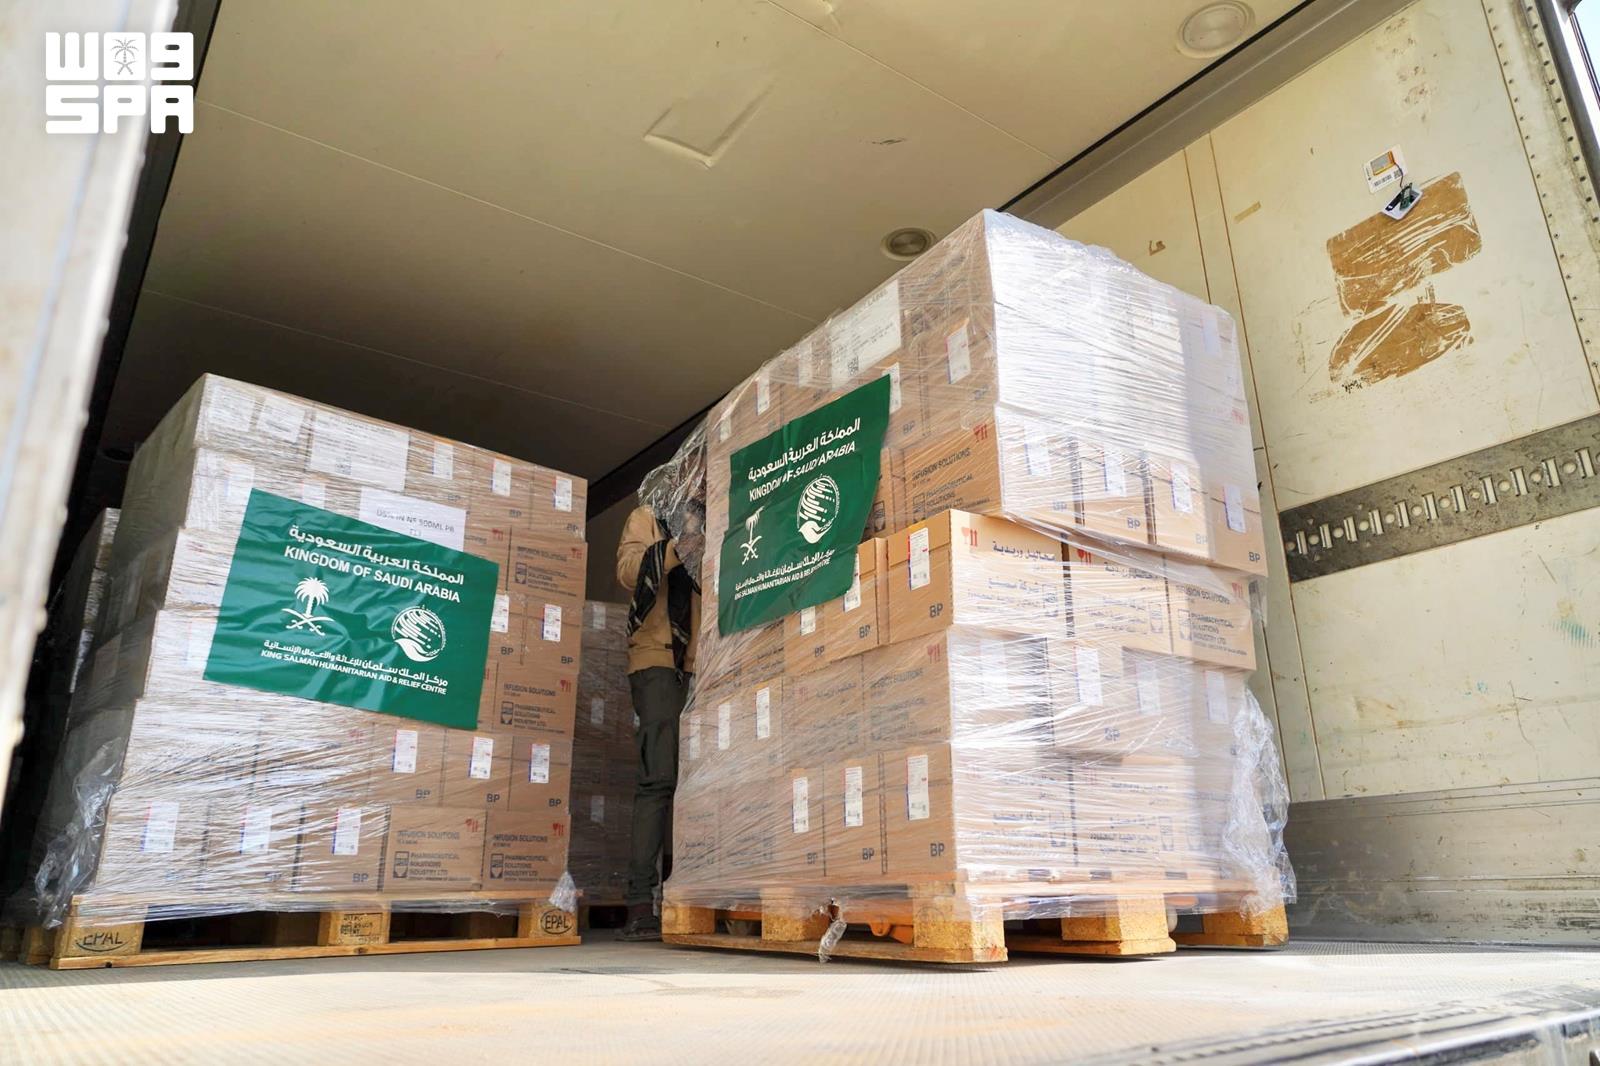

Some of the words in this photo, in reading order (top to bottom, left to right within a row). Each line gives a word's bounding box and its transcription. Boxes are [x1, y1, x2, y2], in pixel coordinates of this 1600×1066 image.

[820, 417, 861, 446] المملكة
[748, 452, 788, 483] السعودية
[1127, 517, 1141, 529] BP
[288, 525, 362, 557] السعودية
[363, 546, 410, 571] العربية
[1248, 551, 1261, 563] BP
[284, 545, 350, 573] KINGDOM
[352, 564, 372, 579] OF
[374, 569, 414, 591] SAUDI
[415, 581, 461, 603] ARABIA
[411, 560, 464, 586] المملكة
[929, 603, 943, 618] BP
[859, 624, 871, 639] BP
[500, 646, 514, 656] BP
[814, 645, 825, 657] BP
[361, 658, 398, 675] سلمان
[560, 655, 573, 665] BP
[261, 649, 283, 662] KING
[283, 652, 319, 669] SALMAN
[319, 659, 378, 681] HUMANITARIAN
[378, 673, 393, 684] AID
[392, 676, 399, 685] &
[398, 677, 422, 690] RELIEF
[421, 681, 448, 696] CENTRE
[398, 667, 425, 682] الملك
[424, 672, 449, 688] مركز
[415, 789, 431, 799] BP
[487, 793, 500, 803] BP
[549, 798, 562, 808] BP
[427, 831, 460, 841] SOLUTIONS
[519, 835, 549, 844] SOLUTIONS
[863, 847, 875, 861] BP
[930, 843, 945, 858] BP
[352, 872, 369, 883] BP
[544, 914, 569, 930] EPAL
